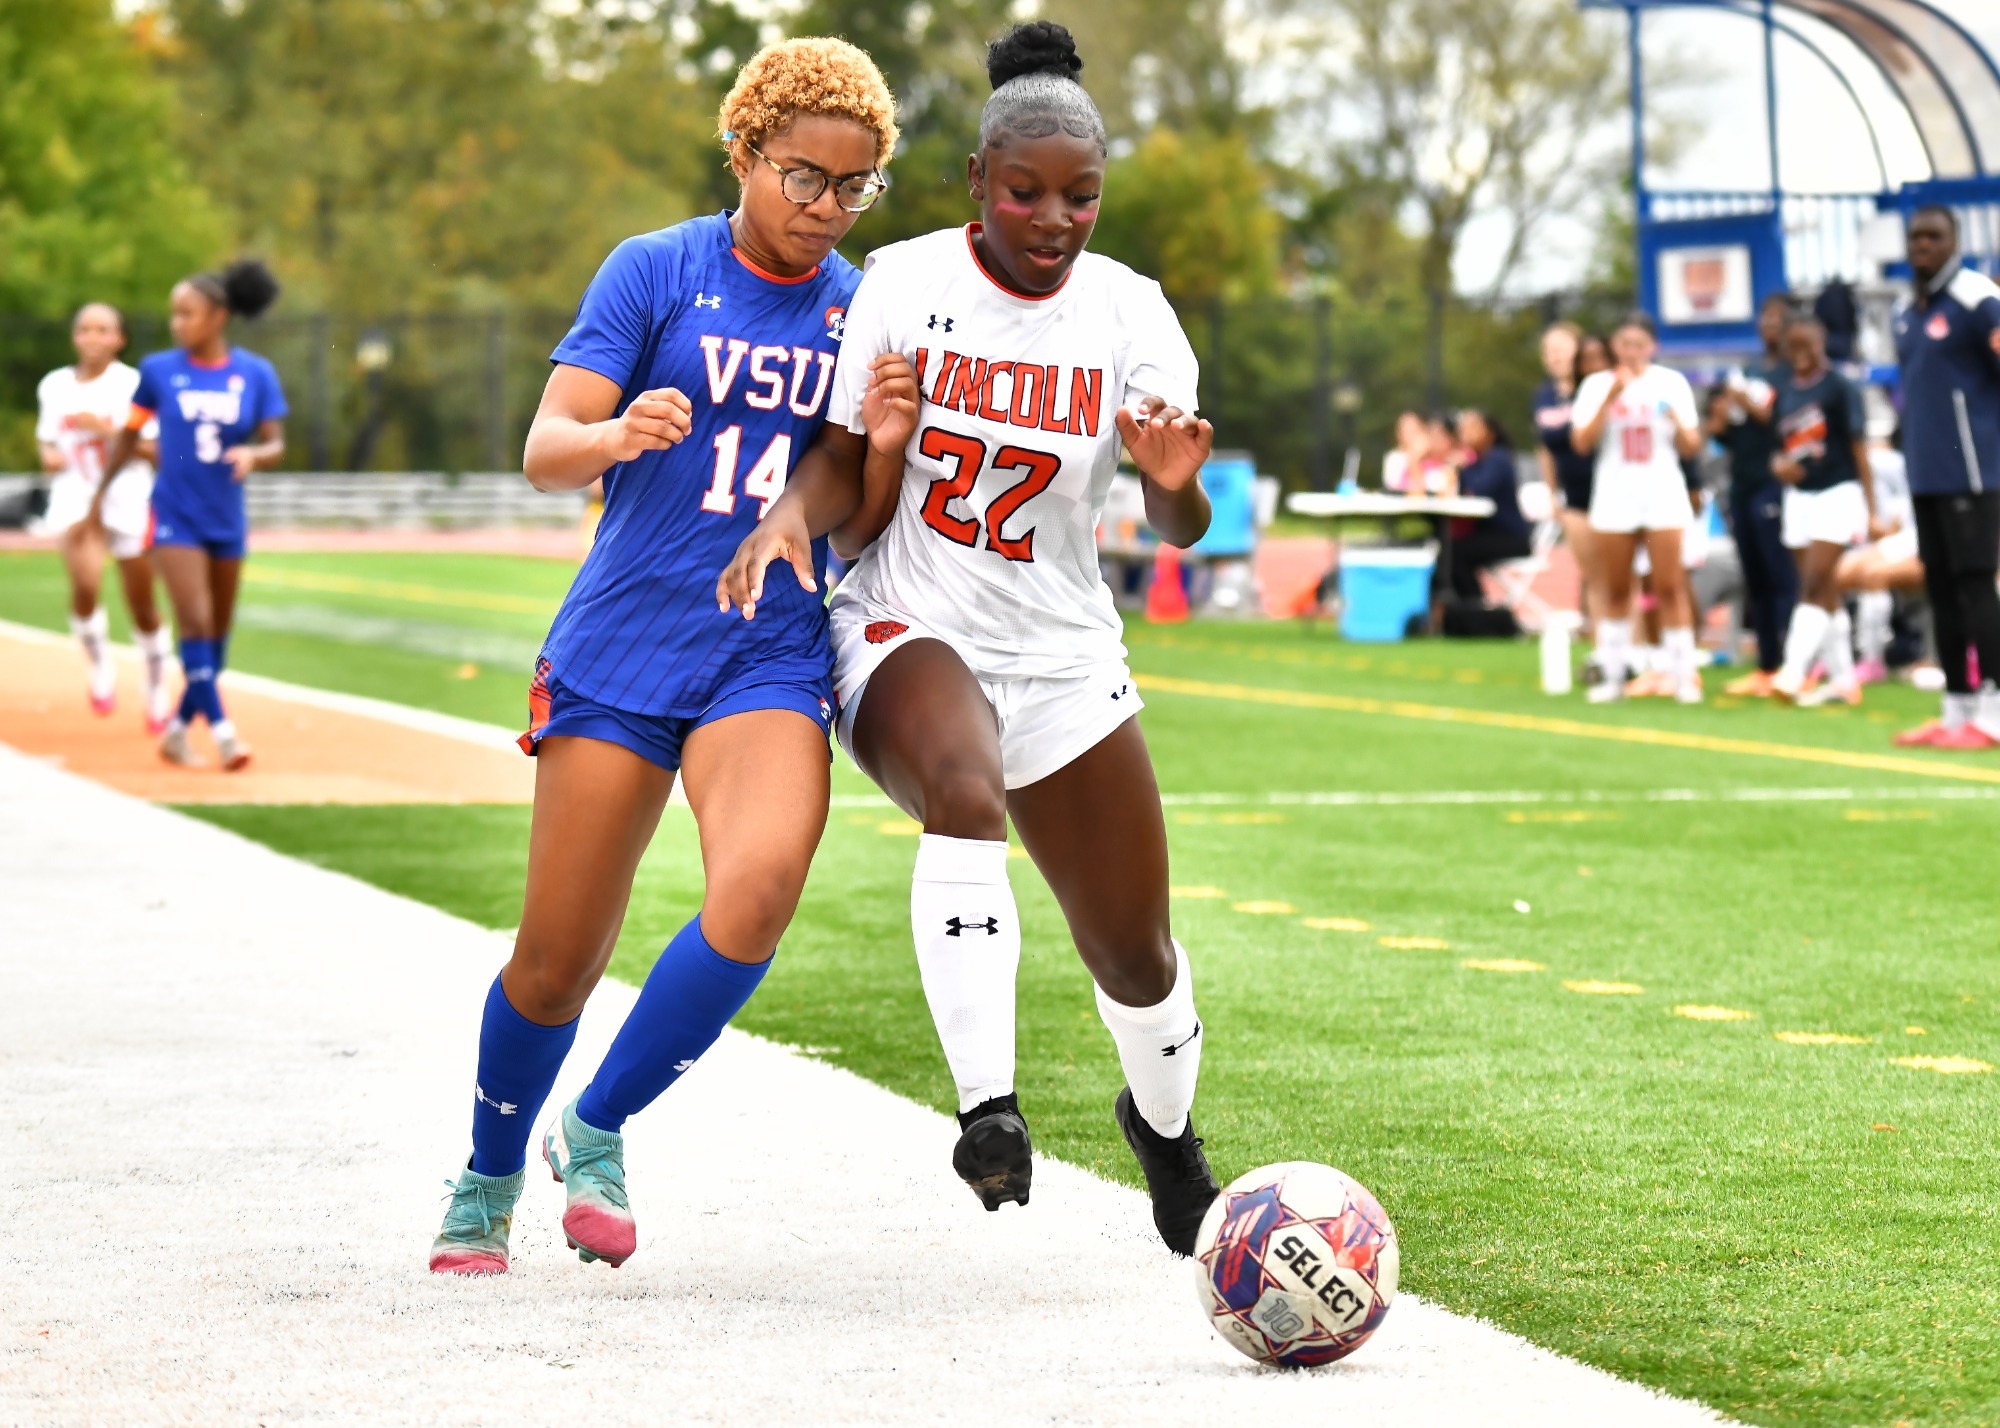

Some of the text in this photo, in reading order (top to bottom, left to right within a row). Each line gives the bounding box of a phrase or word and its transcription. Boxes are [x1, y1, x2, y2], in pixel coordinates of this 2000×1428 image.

[699, 334, 836, 419] VSU
[915, 346, 1103, 437] LINCOLN
[700, 424, 792, 521] 14
[919, 425, 1062, 563] 22
[1261, 1297, 1305, 1338] 10
[1273, 1235, 1366, 1323] SELECT
